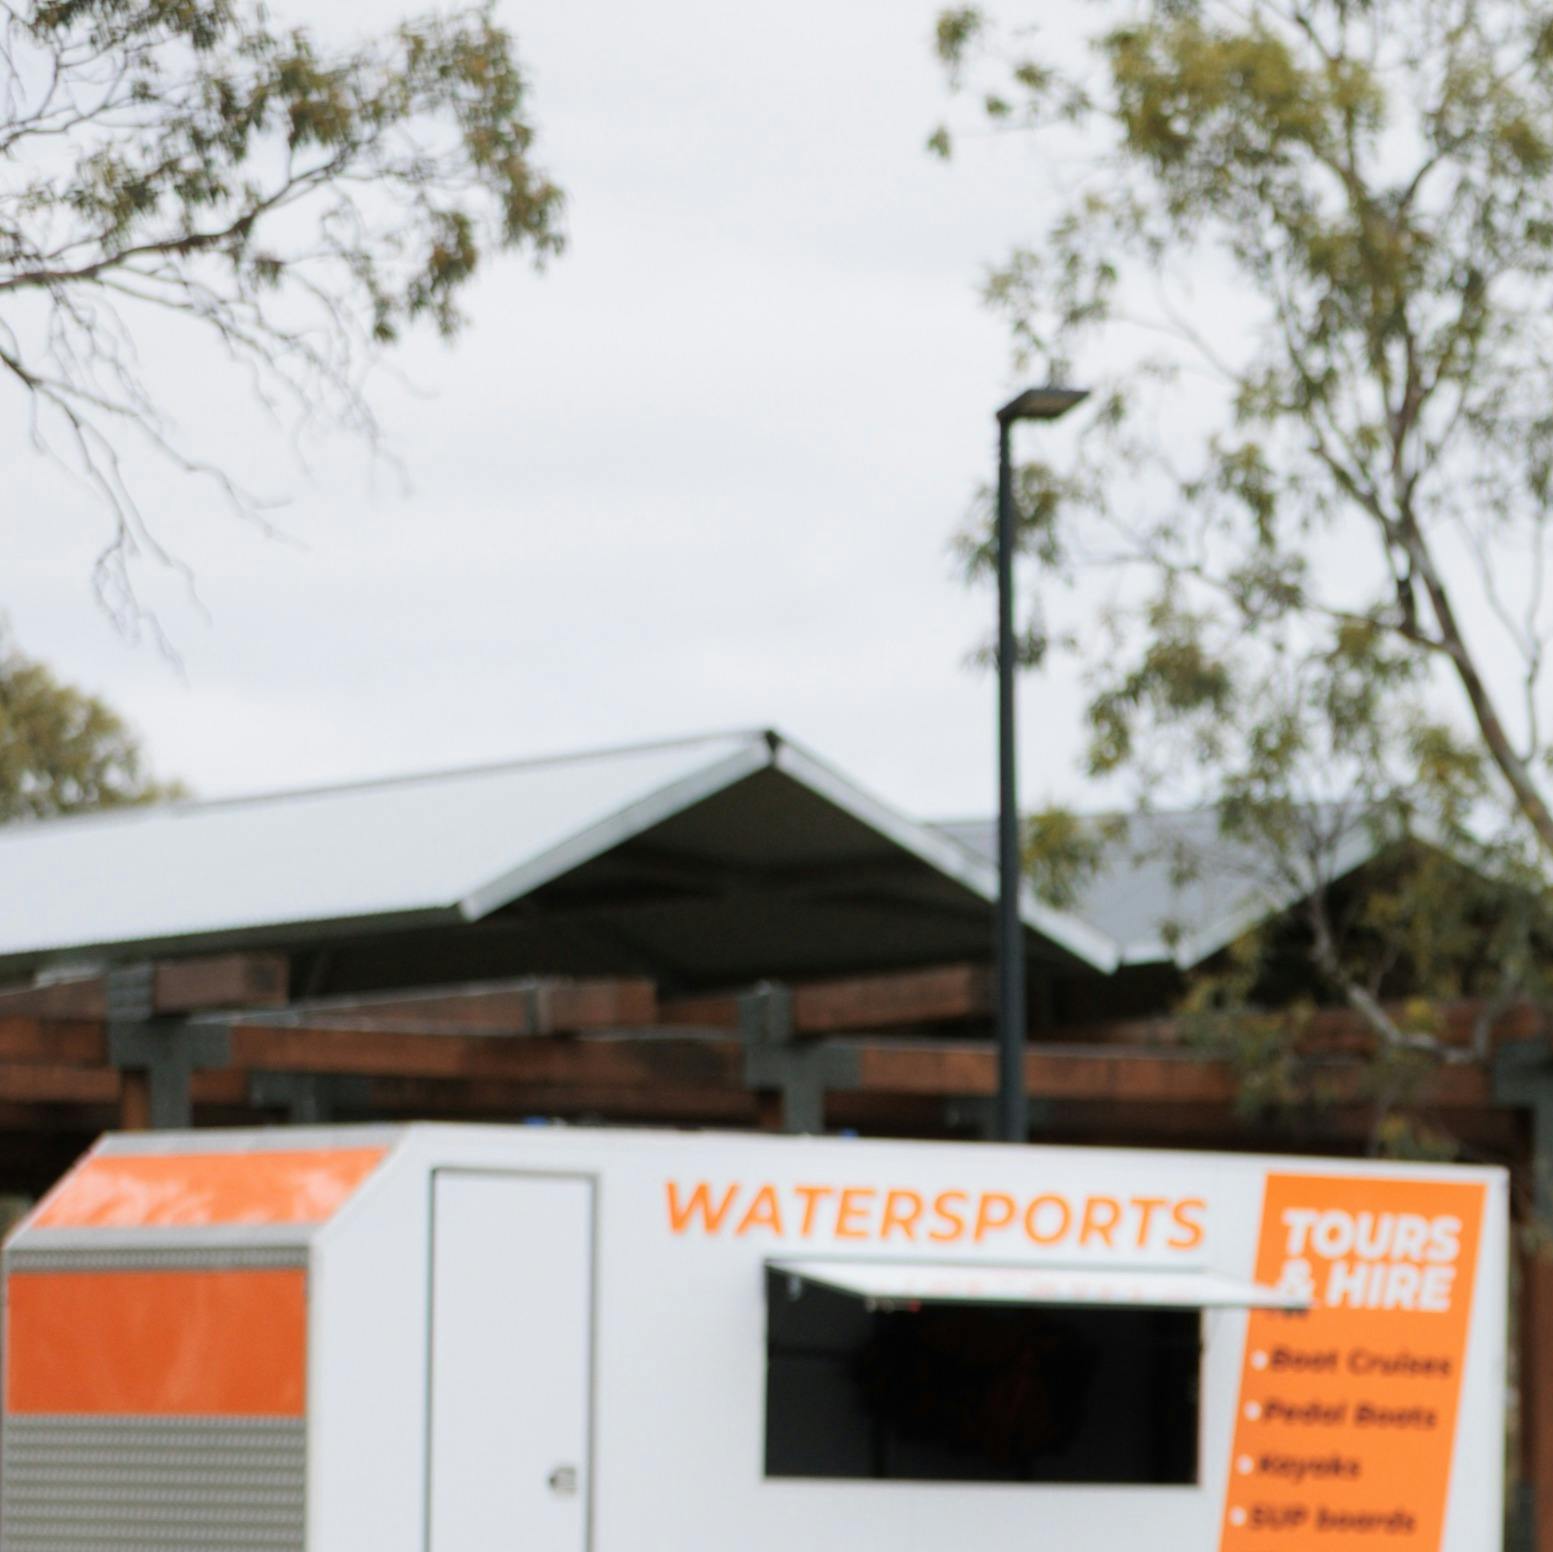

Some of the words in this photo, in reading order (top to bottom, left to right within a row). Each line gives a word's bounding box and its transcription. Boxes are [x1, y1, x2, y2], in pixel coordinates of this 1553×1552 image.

[664, 1180, 1206, 1250] WATERSPORTS
[1283, 1208, 1462, 1263] TOURS
[1326, 1260, 1457, 1312] HIRE
[1271, 1346, 1338, 1373] Boat
[1347, 1348, 1453, 1377] Cruises
[1263, 1398, 1346, 1425] Pedal
[1354, 1402, 1438, 1430] Boats
[1259, 1453, 1361, 1485] Kayaks
[1251, 1505, 1308, 1530] SUP
[1316, 1507, 1416, 1534] boards
